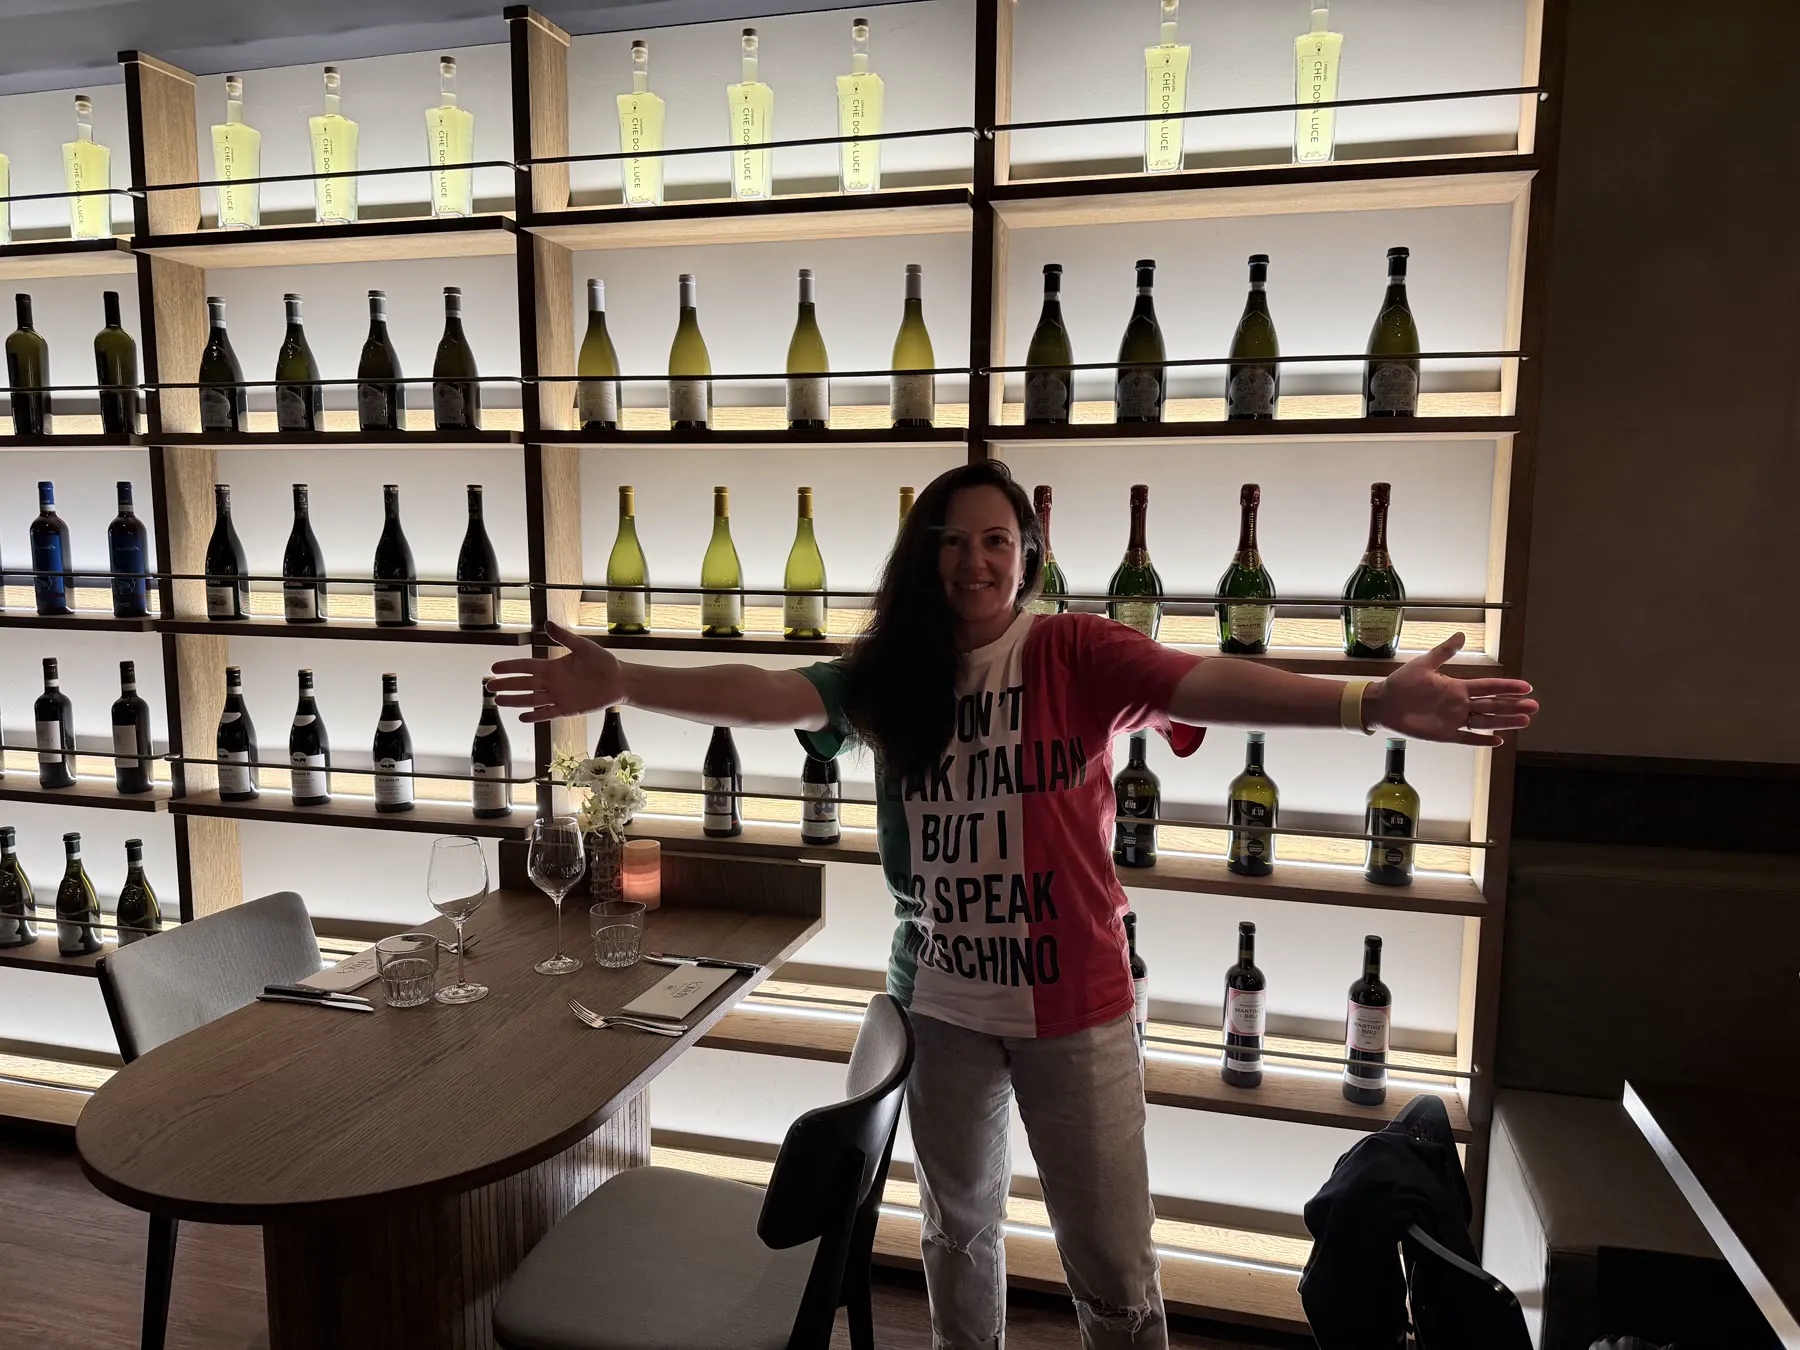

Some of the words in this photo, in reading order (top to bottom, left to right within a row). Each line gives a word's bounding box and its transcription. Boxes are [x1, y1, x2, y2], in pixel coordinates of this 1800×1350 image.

[1162, 72, 1170, 93] CHE
[1313, 61, 1322, 81] CHE
[742, 108, 750, 126] CHE
[852, 99, 860, 117] CHE
[743, 128, 751, 156] DOA
[852, 120, 860, 148] DOA
[1160, 125, 1169, 152] LUCE
[1310, 117, 1319, 143] LUCE
[632, 138, 640, 164] DOA
[852, 150, 860, 173] LUCE
[955, 686, 1027, 743] ON'T
[966, 736, 1088, 802] ITALIAN
[922, 811, 984, 865] BUT
[997, 809, 1008, 860] I
[933, 870, 1059, 924] SPEAK
[1353, 1021, 1385, 1030] MARTINET
